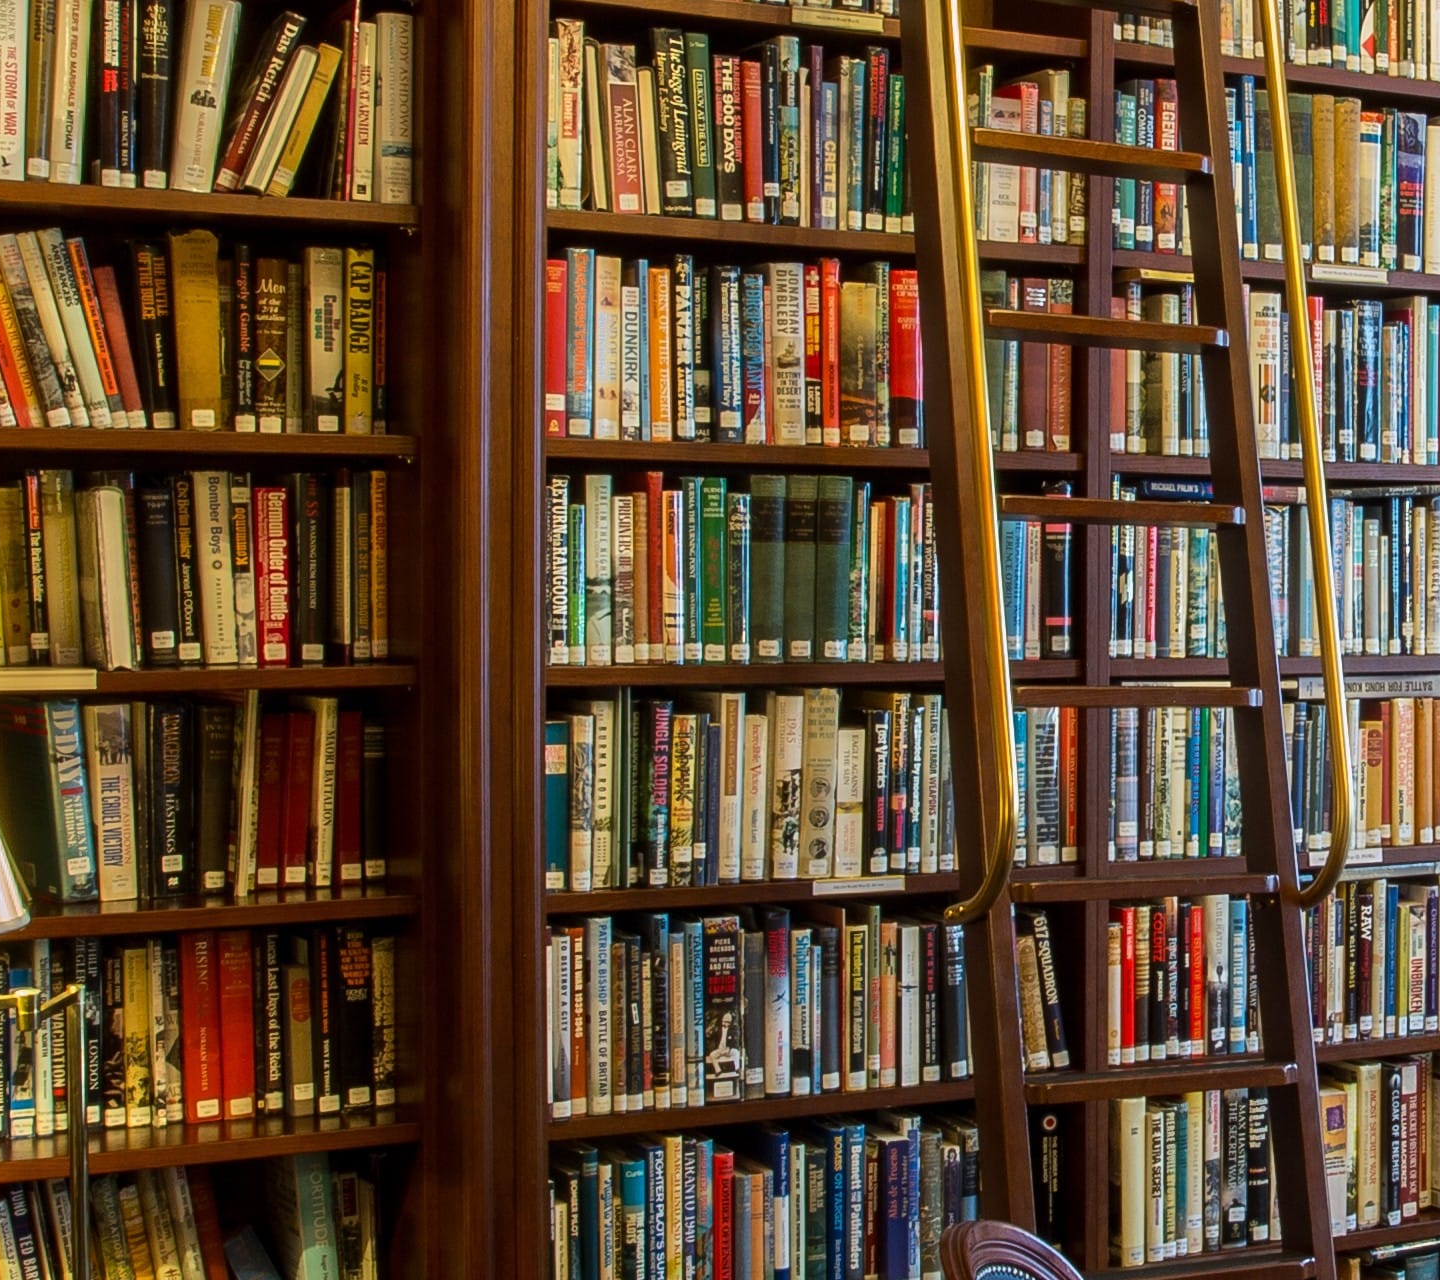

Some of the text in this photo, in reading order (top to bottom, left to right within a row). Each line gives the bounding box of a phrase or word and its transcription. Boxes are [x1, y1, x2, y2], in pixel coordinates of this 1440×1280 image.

[255, 22, 300, 103] Das Reich
[4, 64, 18, 136] STORM WAR
[722, 58, 735, 174] THE 900 DAYS
[614, 104, 626, 176] BARBAROSSA
[623, 98, 638, 183] ALAN CLARK
[824, 141, 833, 194] CRETE
[257, 278, 286, 294] Men
[349, 262, 372, 354] CAP BADGE
[775, 269, 788, 334] DIMBLEBY
[788, 269, 799, 334] JONATHAN
[624, 310, 639, 383] DUNKIRK
[207, 476, 222, 562] Bomber Boys
[268, 492, 287, 621] German Order Battle
[52, 707, 80, 787] D-DAY
[654, 707, 669, 805] JUNGLE SOLDIER
[794, 936, 810, 1004] Shiphunters
[1034, 917, 1059, 1004] 617 SQUADRON
[1410, 958, 1422, 1013] UNBROKEN
[20, 1233, 35, 1253] TED
